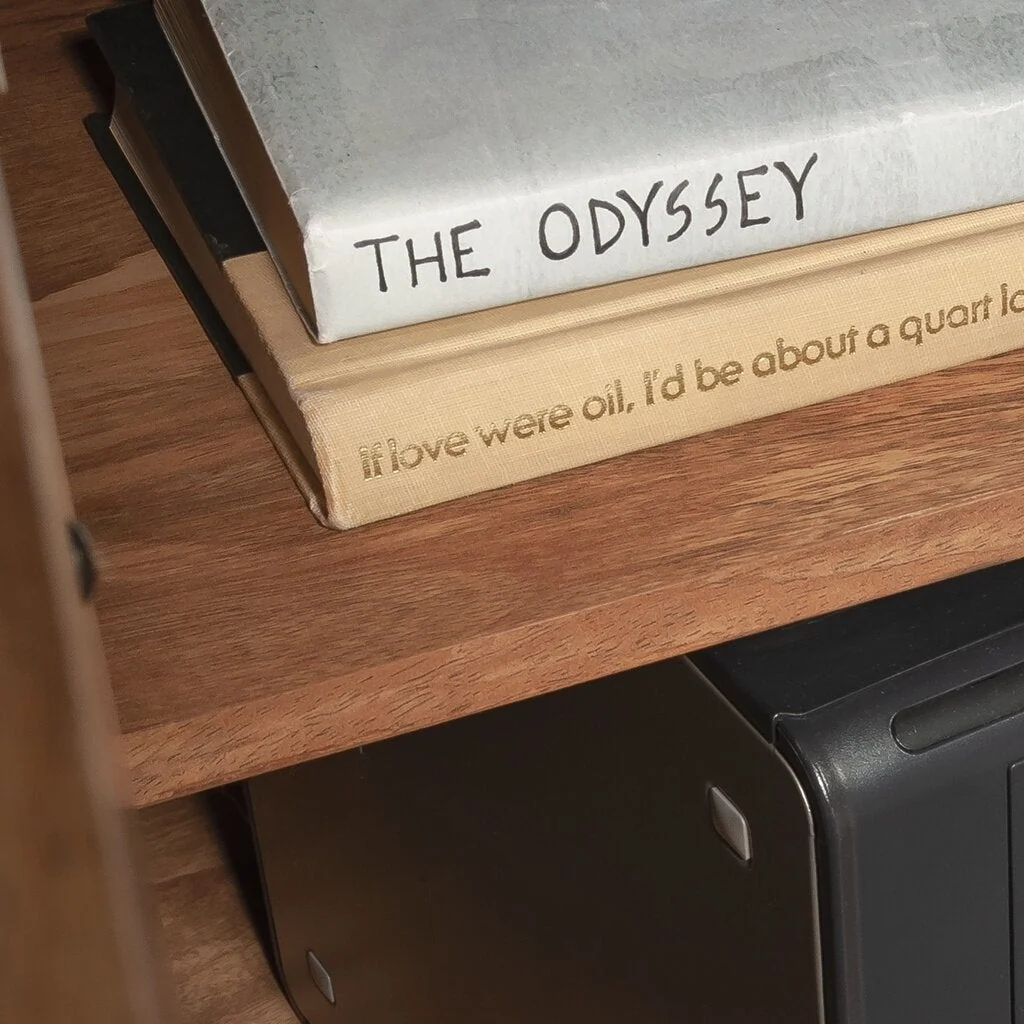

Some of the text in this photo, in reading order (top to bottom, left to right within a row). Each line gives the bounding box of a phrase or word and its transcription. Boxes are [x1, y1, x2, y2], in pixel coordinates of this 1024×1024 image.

[353, 152, 818, 293] THE ODYSSEY
[358, 437, 384, 482] If
[387, 429, 470, 475] love
[475, 402, 574, 449] were
[582, 378, 635, 423] oil,
[643, 362, 686, 406] I'd
[696, 358, 744, 393] be
[751, 322, 858, 378] about
[866, 320, 892, 349] a
[898, 292, 992, 347] quart
